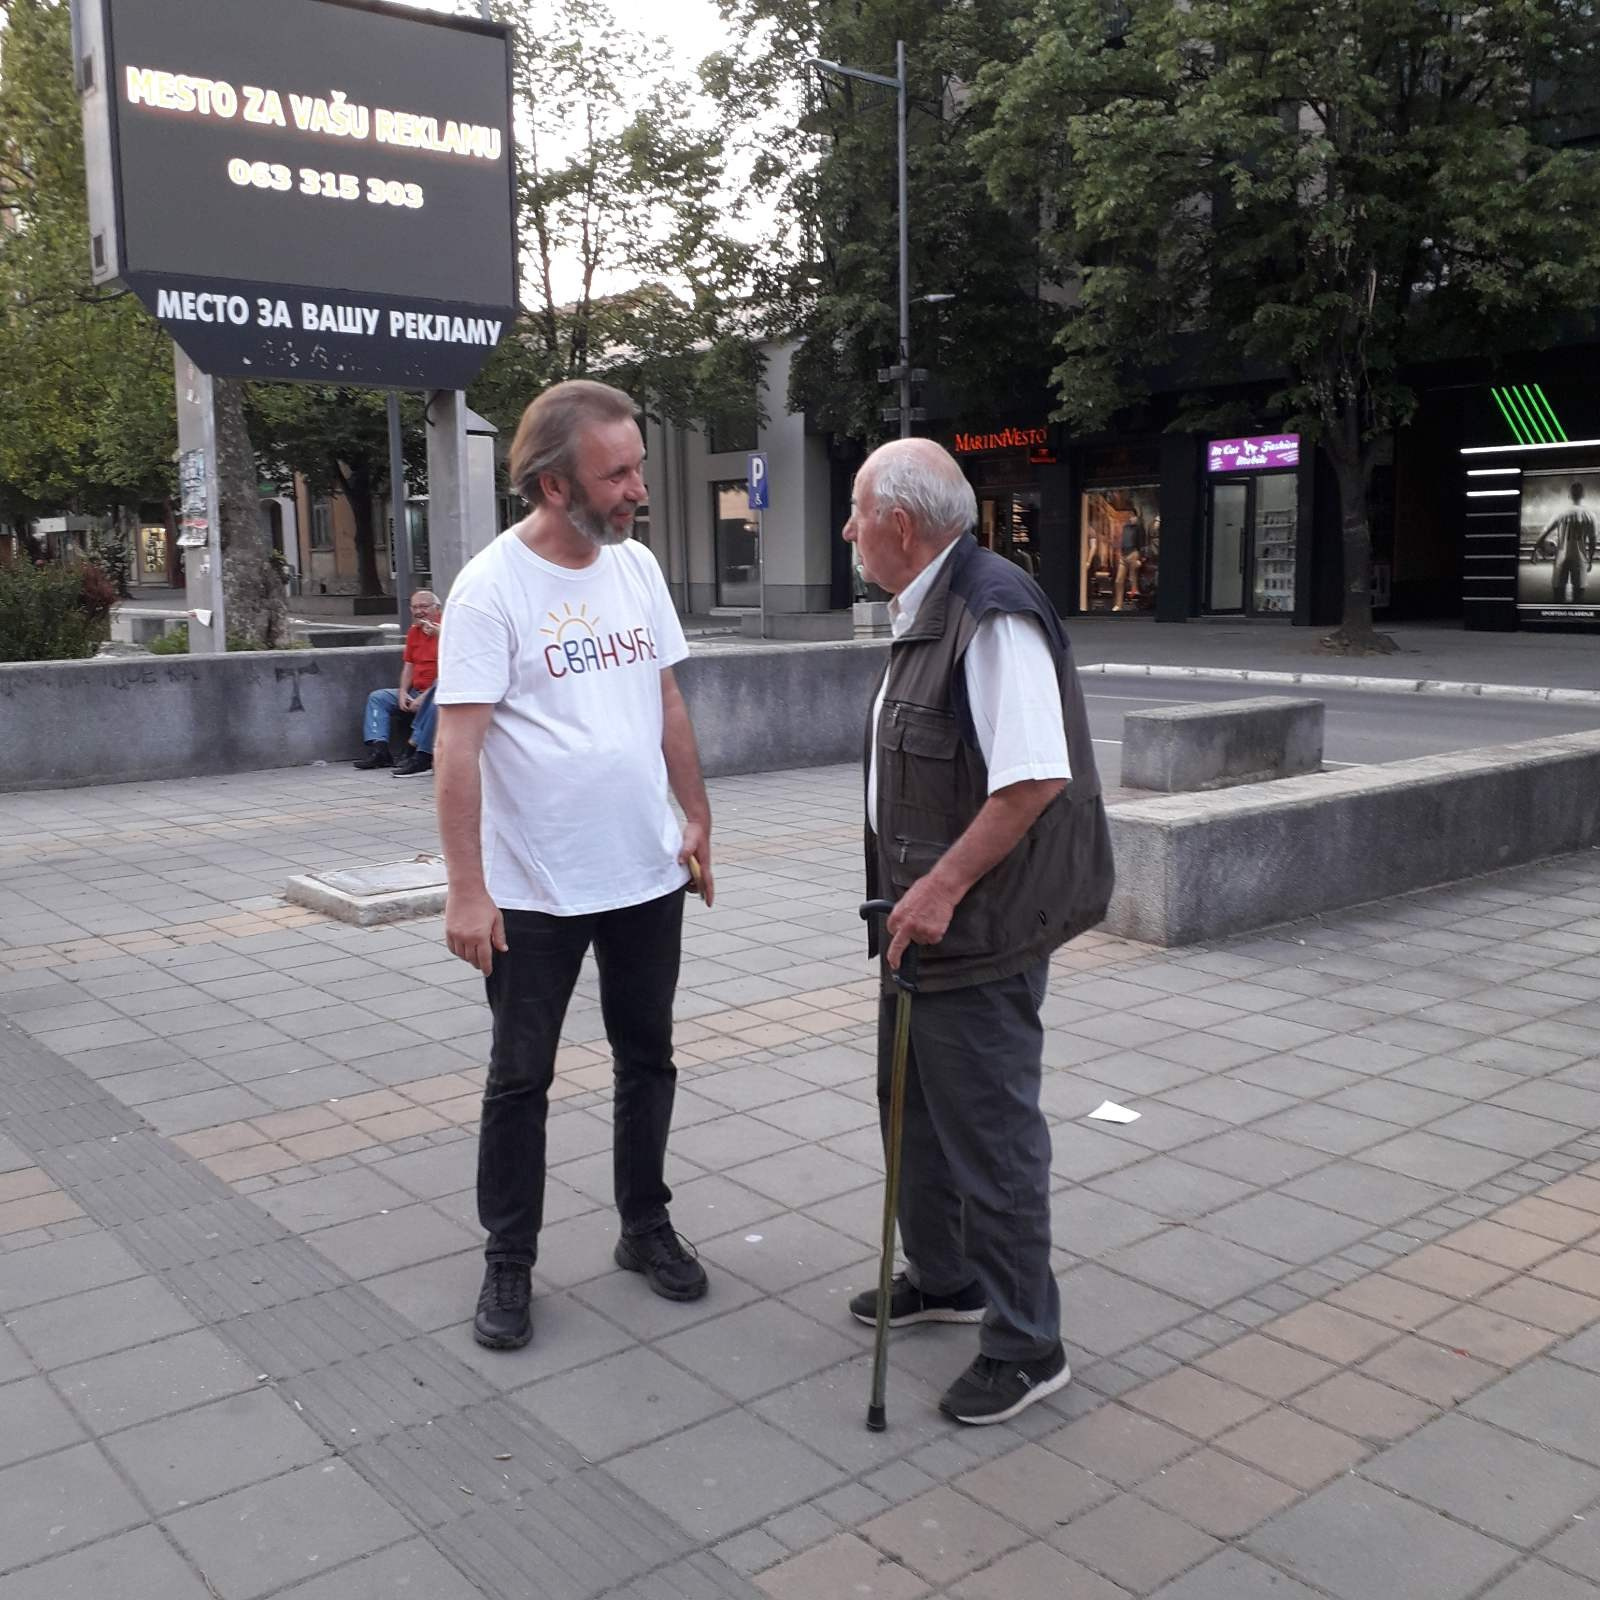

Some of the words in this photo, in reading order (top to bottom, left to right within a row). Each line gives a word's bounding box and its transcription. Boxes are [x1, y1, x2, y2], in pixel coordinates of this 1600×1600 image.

[126, 66, 238, 118] MESTO
[242, 86, 287, 127] ZA
[289, 90, 369, 139] VAŠU
[375, 109, 501, 160] REKLAMU
[227, 158, 292, 191] 063
[299, 168, 360, 200] 315
[366, 178, 424, 209] 303
[157, 289, 249, 325] МЕСТО
[256, 298, 293, 329] ЗА
[301, 302, 380, 336] ВАШУ
[389, 310, 502, 346] РЕКЛАМУ
[752, 457, 765, 487] P
